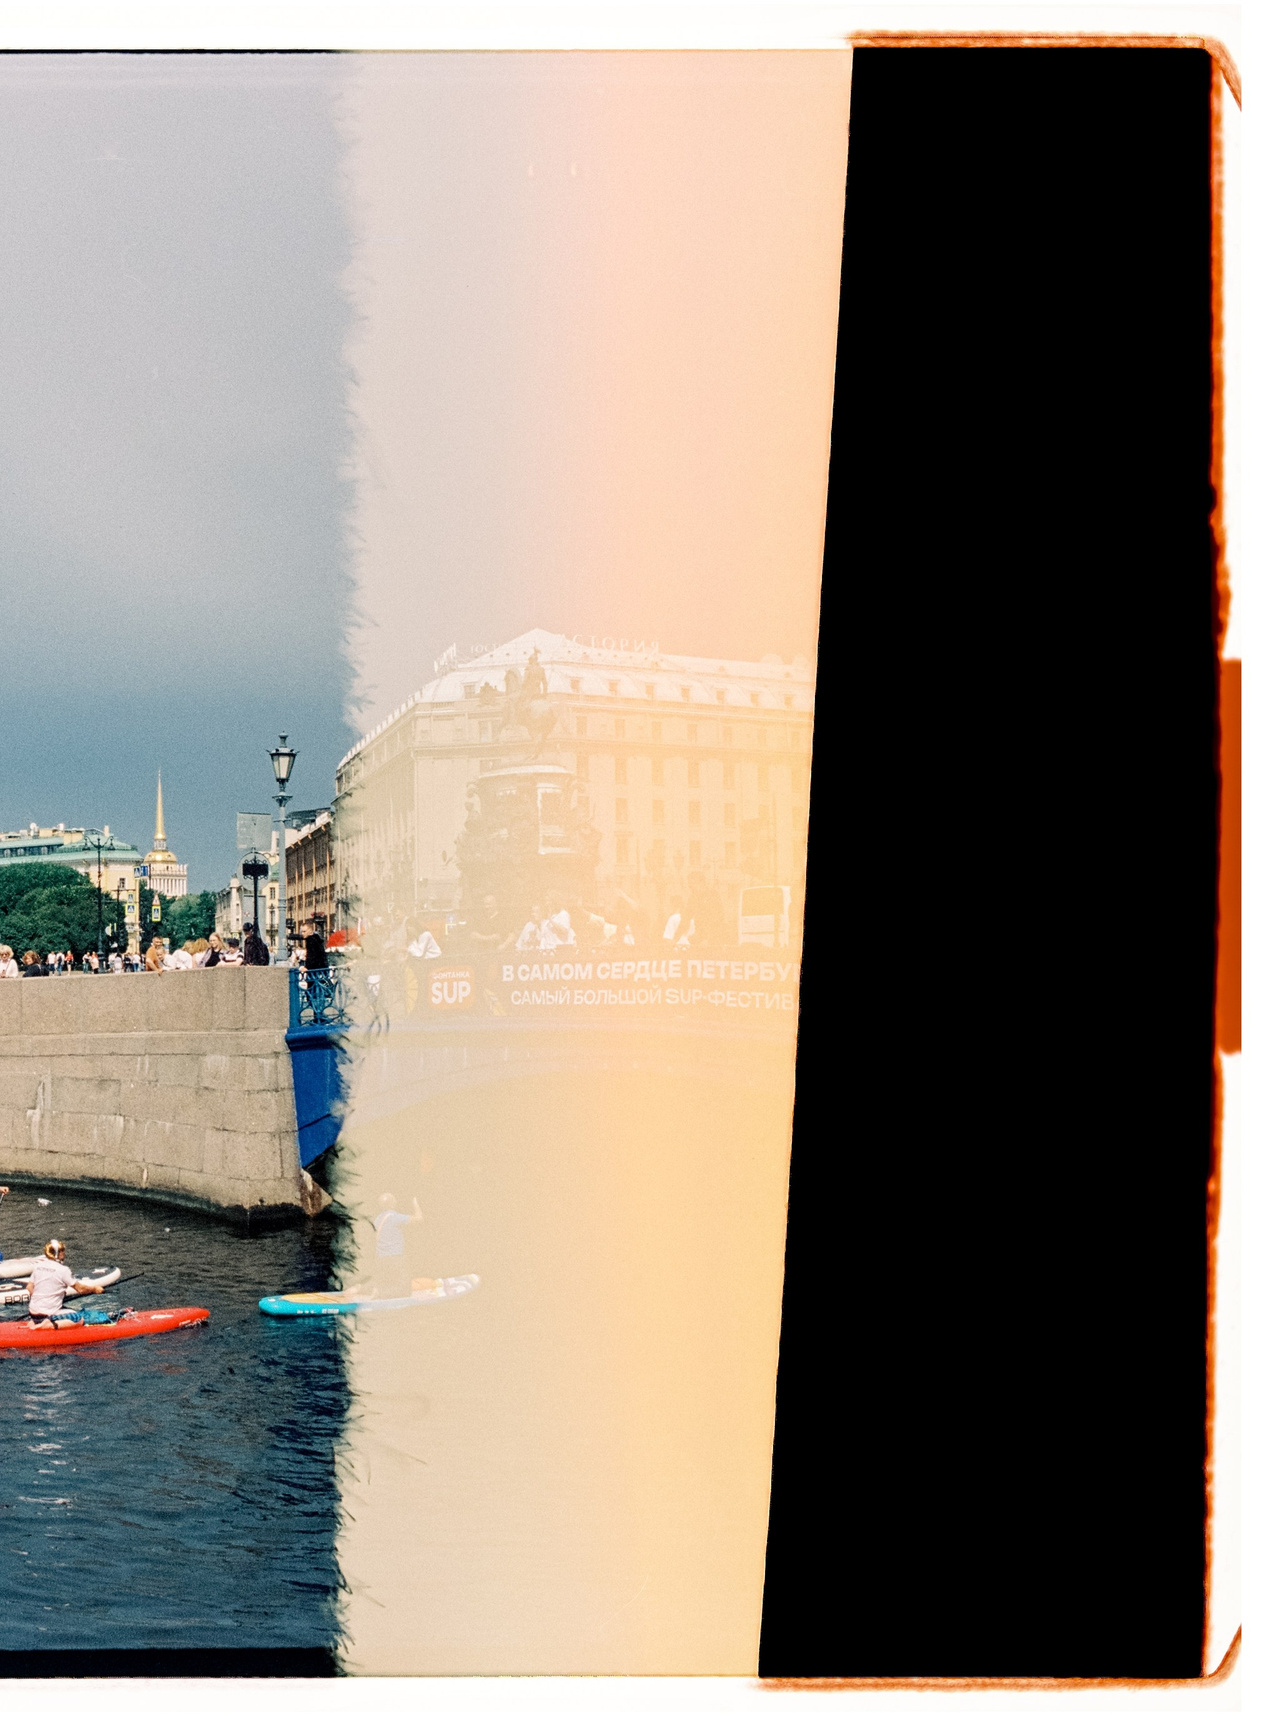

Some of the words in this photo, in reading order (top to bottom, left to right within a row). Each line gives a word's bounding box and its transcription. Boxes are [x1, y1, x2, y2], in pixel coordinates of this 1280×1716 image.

[502, 964, 515, 982] В
[517, 962, 594, 982] САМОМ
[596, 959, 682, 983] СЕРДЦЕ
[431, 981, 471, 1004] SUP
[510, 986, 572, 1005] САМЫЙ
[573, 984, 662, 1006] БОЛЬШОЙ
